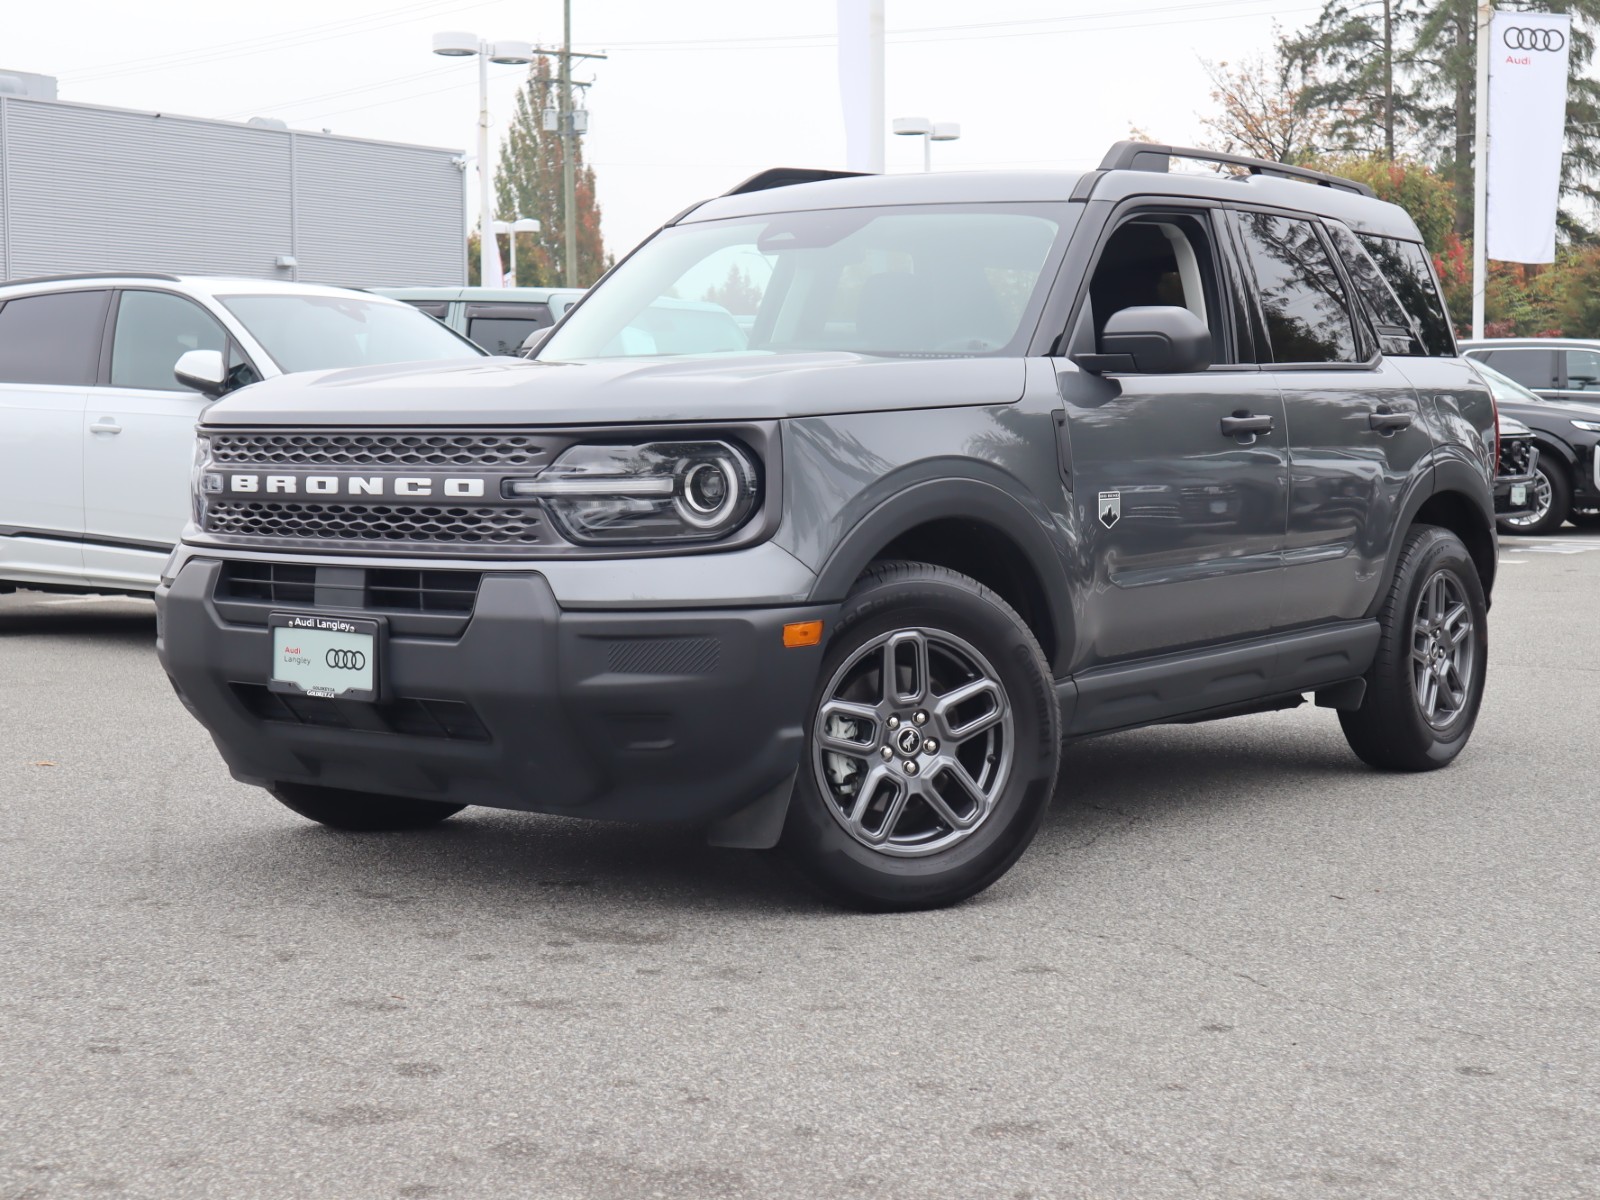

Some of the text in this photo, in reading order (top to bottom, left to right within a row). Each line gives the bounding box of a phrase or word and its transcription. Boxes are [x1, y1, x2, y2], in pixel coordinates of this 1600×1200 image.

[1505, 56, 1531, 65] Audi
[230, 474, 485, 497] BRONCO
[294, 617, 350, 631] Audi Langley
[284, 646, 301, 654] Audi
[283, 655, 311, 666] Langley
